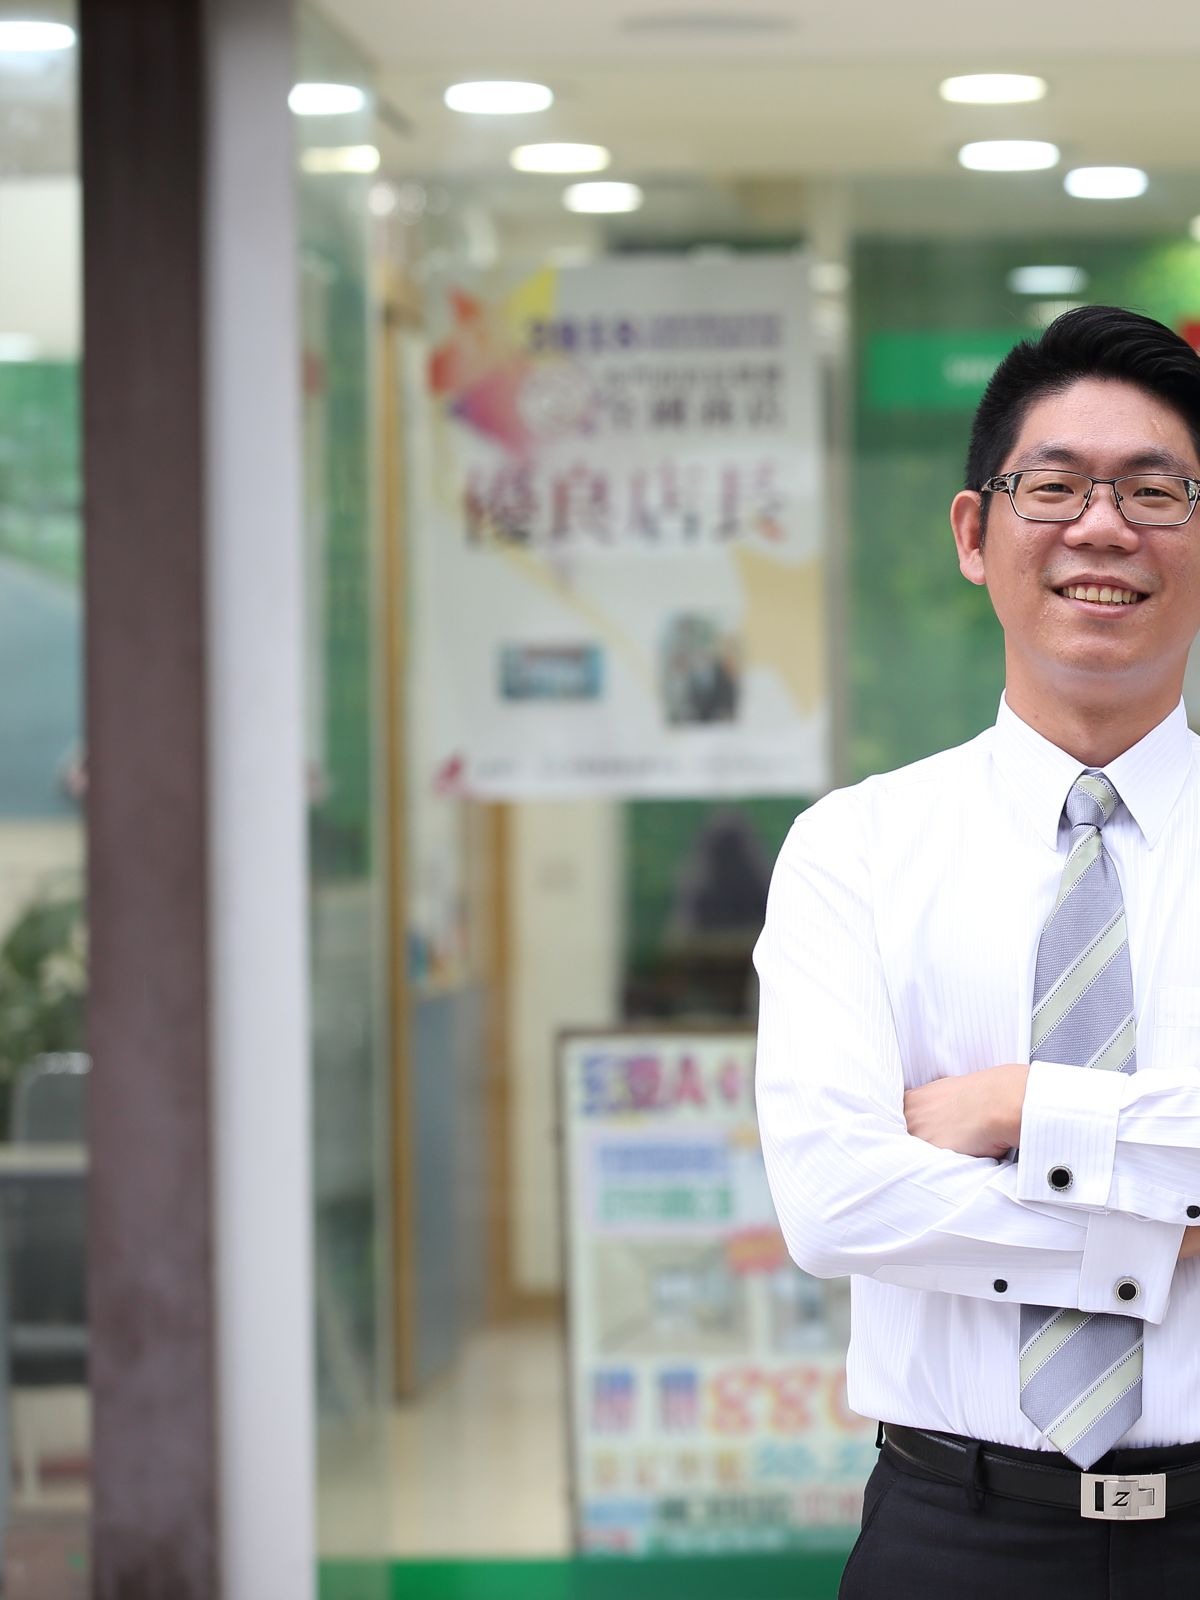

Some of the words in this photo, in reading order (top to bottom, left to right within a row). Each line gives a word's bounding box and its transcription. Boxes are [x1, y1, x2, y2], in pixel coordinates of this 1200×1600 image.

[463, 456, 787, 550] 優良店長
[1112, 1491, 1130, 1507] Z
